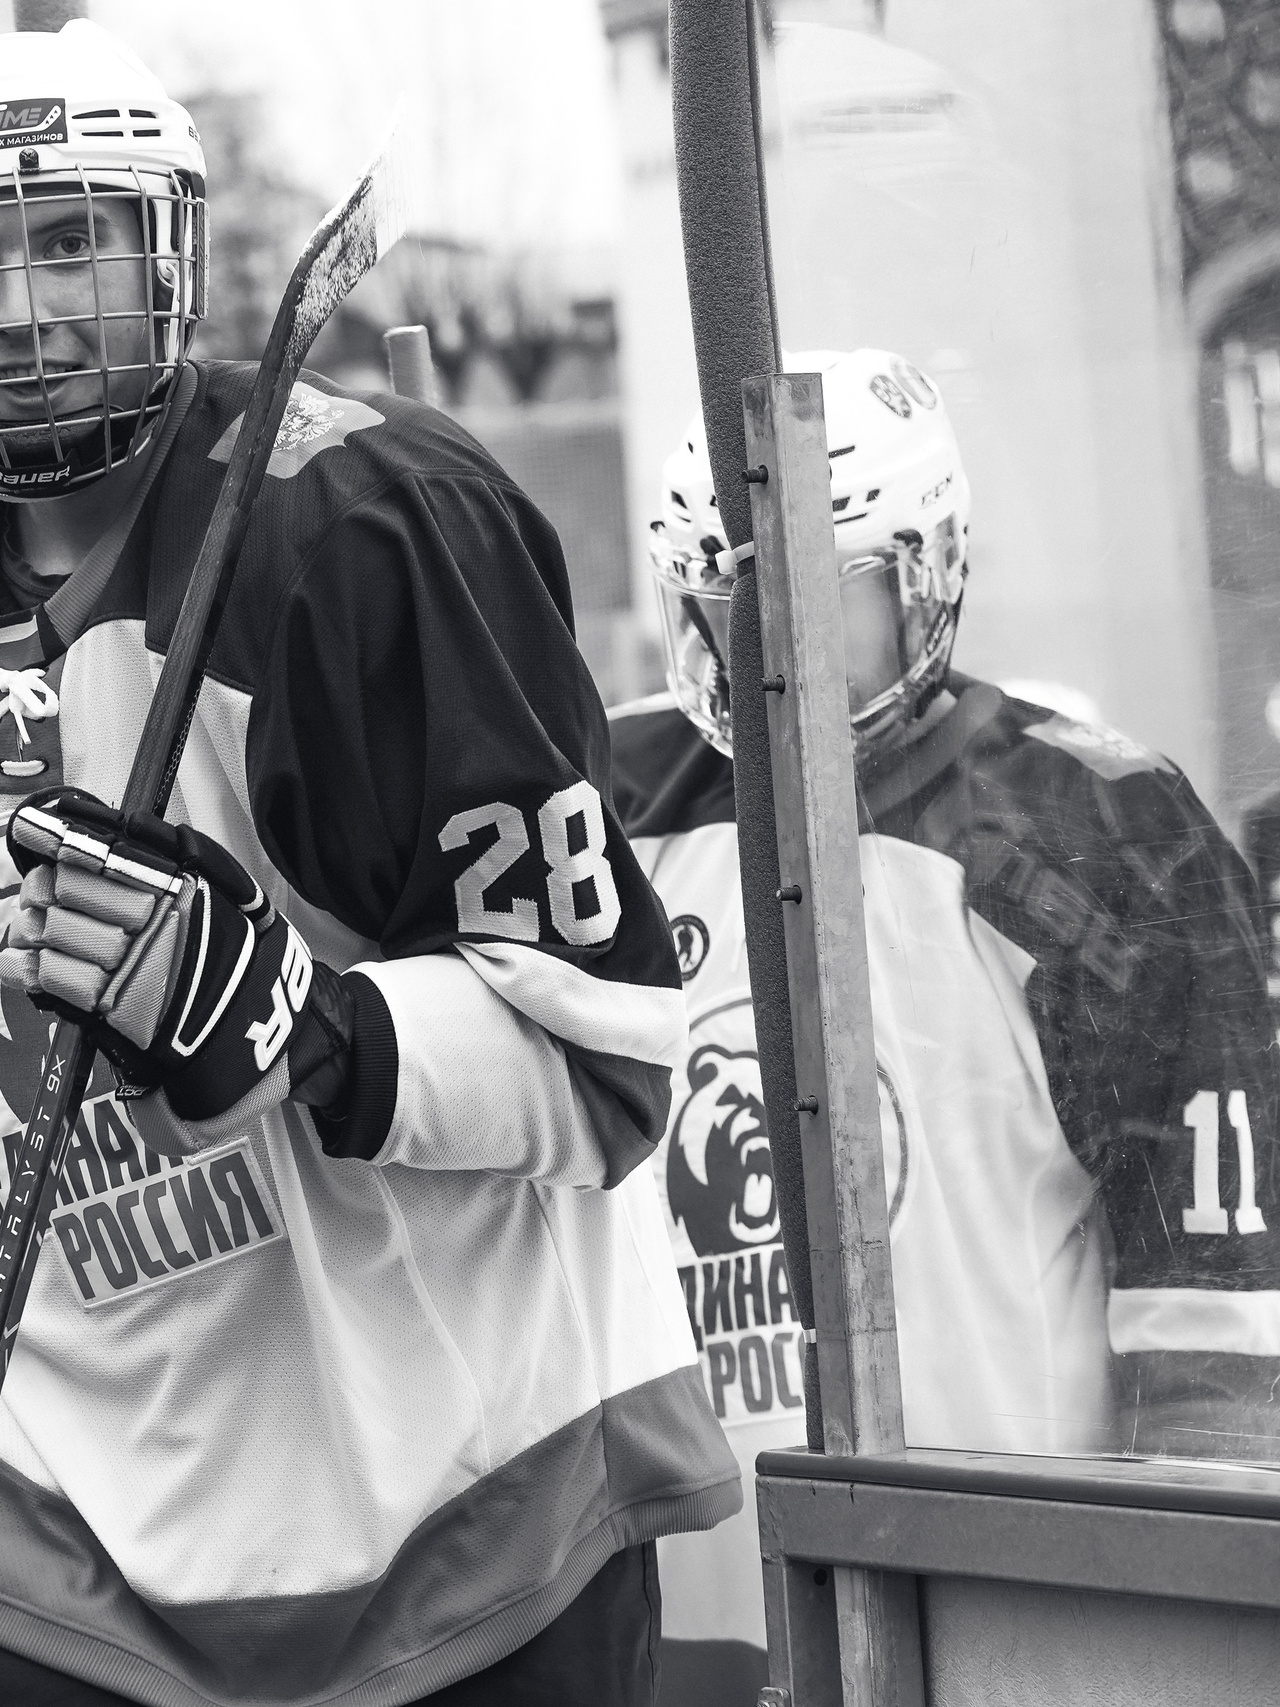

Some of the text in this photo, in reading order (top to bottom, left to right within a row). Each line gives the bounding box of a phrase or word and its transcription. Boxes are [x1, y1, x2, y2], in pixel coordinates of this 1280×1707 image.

[7, 133, 64, 146] МАГАЗИНОВ
[438, 780, 622, 946] 28
[46, 1054, 66, 1094] 9X
[1183, 1089, 1268, 1235] 11
[52, 1151, 274, 1300] РОССИЯ
[706, 1329, 806, 1418] РОС
